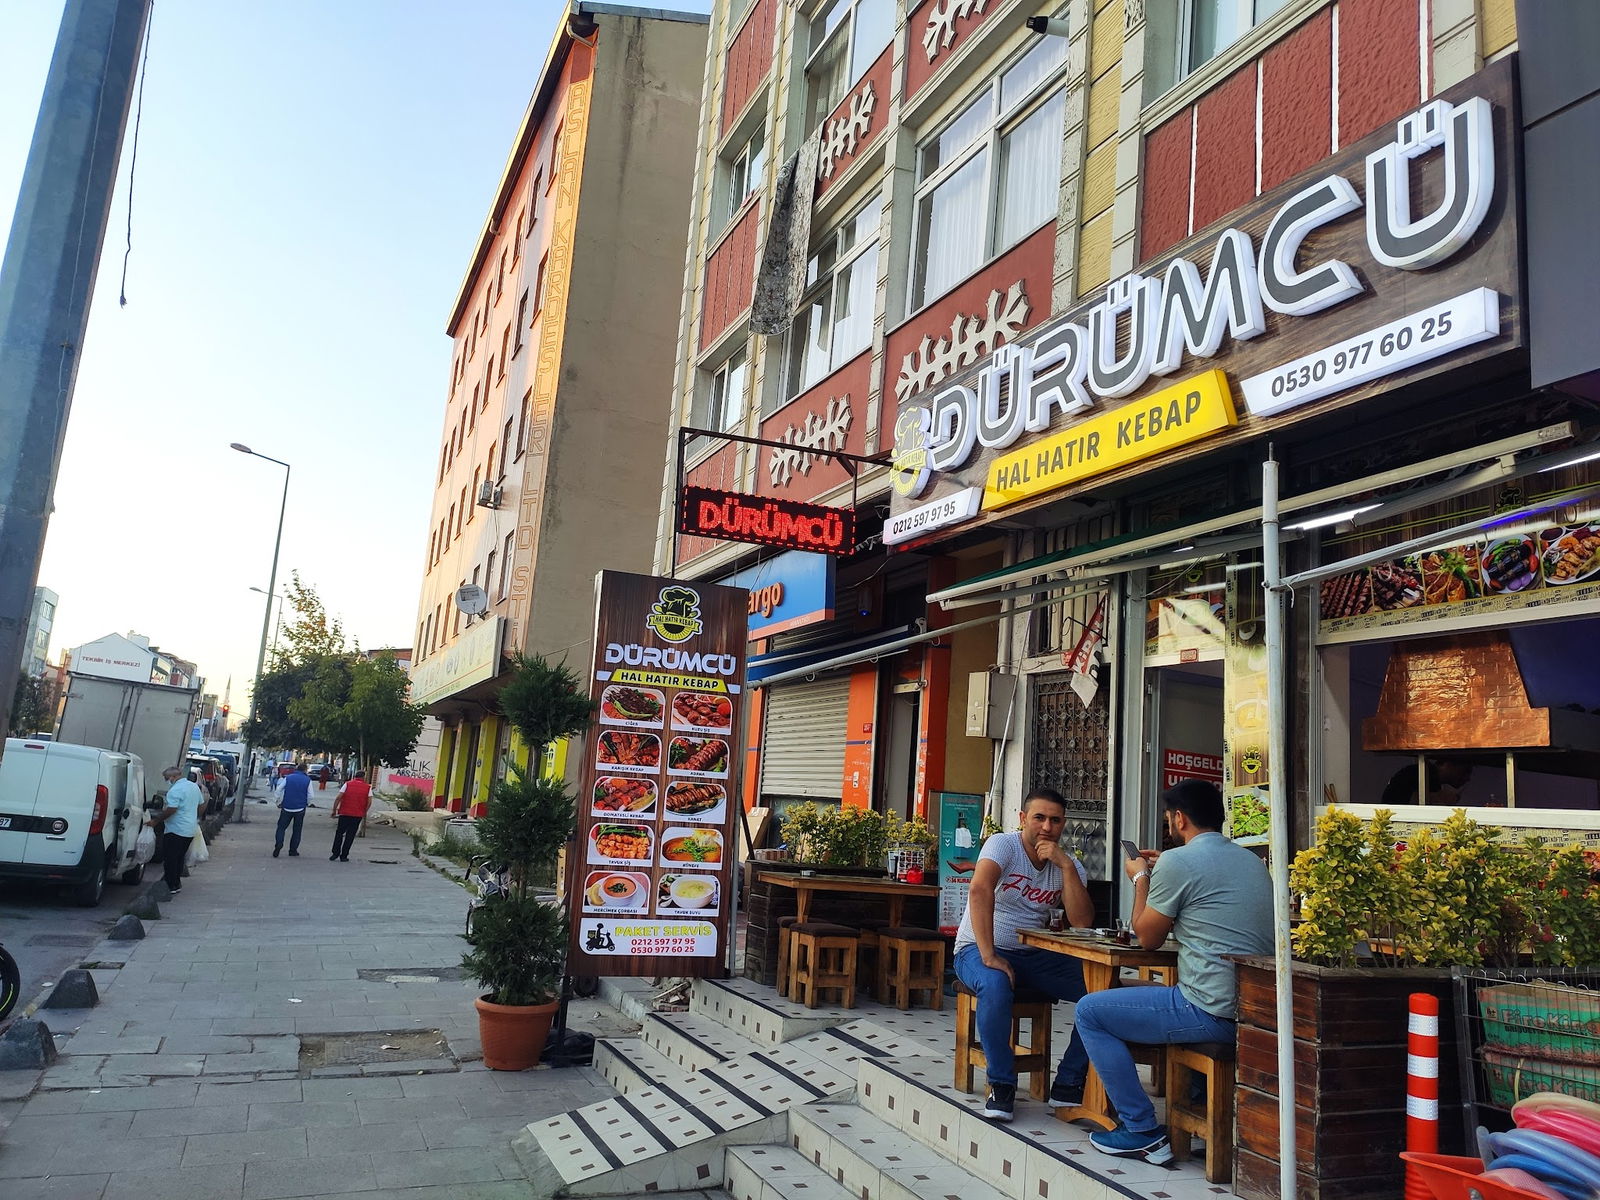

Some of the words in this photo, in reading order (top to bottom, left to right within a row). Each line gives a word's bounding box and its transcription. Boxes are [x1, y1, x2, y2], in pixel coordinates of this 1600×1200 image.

[559, 83, 585, 208] ASLAN
[929, 97, 1494, 472] DÜRÜMCÜ
[1271, 359, 1327, 398] 0530
[1333, 340, 1374, 375] 977
[1379, 326, 1413, 357] 60
[1420, 310, 1452, 343] 25
[996, 458, 1031, 493] HAL
[1036, 431, 1100, 478] HATIR
[1116, 390, 1201, 449] KEBAP
[518, 472, 538, 549] LTD
[698, 497, 843, 547] DÜRÜMCÜ
[893, 517, 912, 535] 0212
[913, 510, 930, 528] 597
[930, 505, 942, 521] 97
[943, 501, 956, 517] 95
[605, 643, 737, 676] DÜRÜMCÜ
[621, 671, 642, 682] HAL
[646, 674, 681, 686] HATIR
[682, 677, 719, 689] KEBAP
[1001, 873, 1062, 906] Focus
[615, 926, 660, 937] PAKET
[663, 922, 712, 937] SERVİS
[630, 946, 653, 954] 0530
